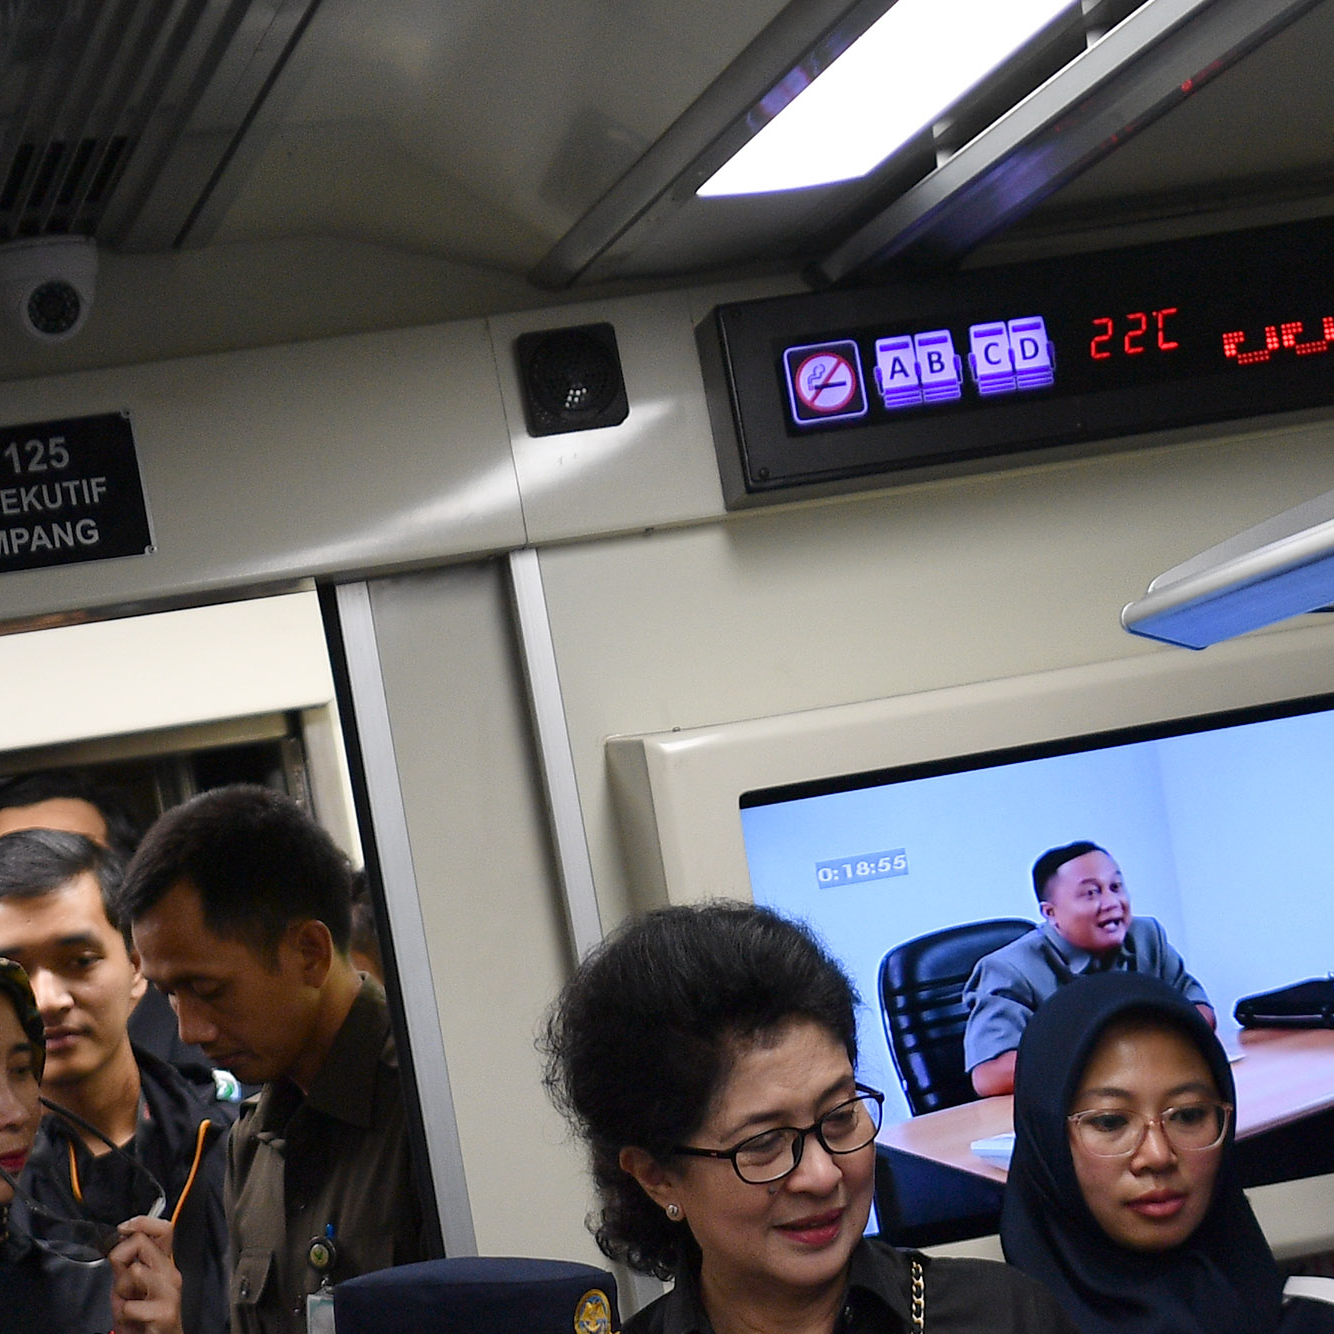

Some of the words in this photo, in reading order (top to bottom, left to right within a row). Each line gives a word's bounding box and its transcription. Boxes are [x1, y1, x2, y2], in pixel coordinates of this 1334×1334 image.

[888, 355, 906, 380] A
[928, 350, 945, 375] B
[983, 342, 1001, 366] C
[1019, 336, 1039, 361] D
[3, 437, 70, 473] 125
[818, 854, 907, 882] 0:18:55
